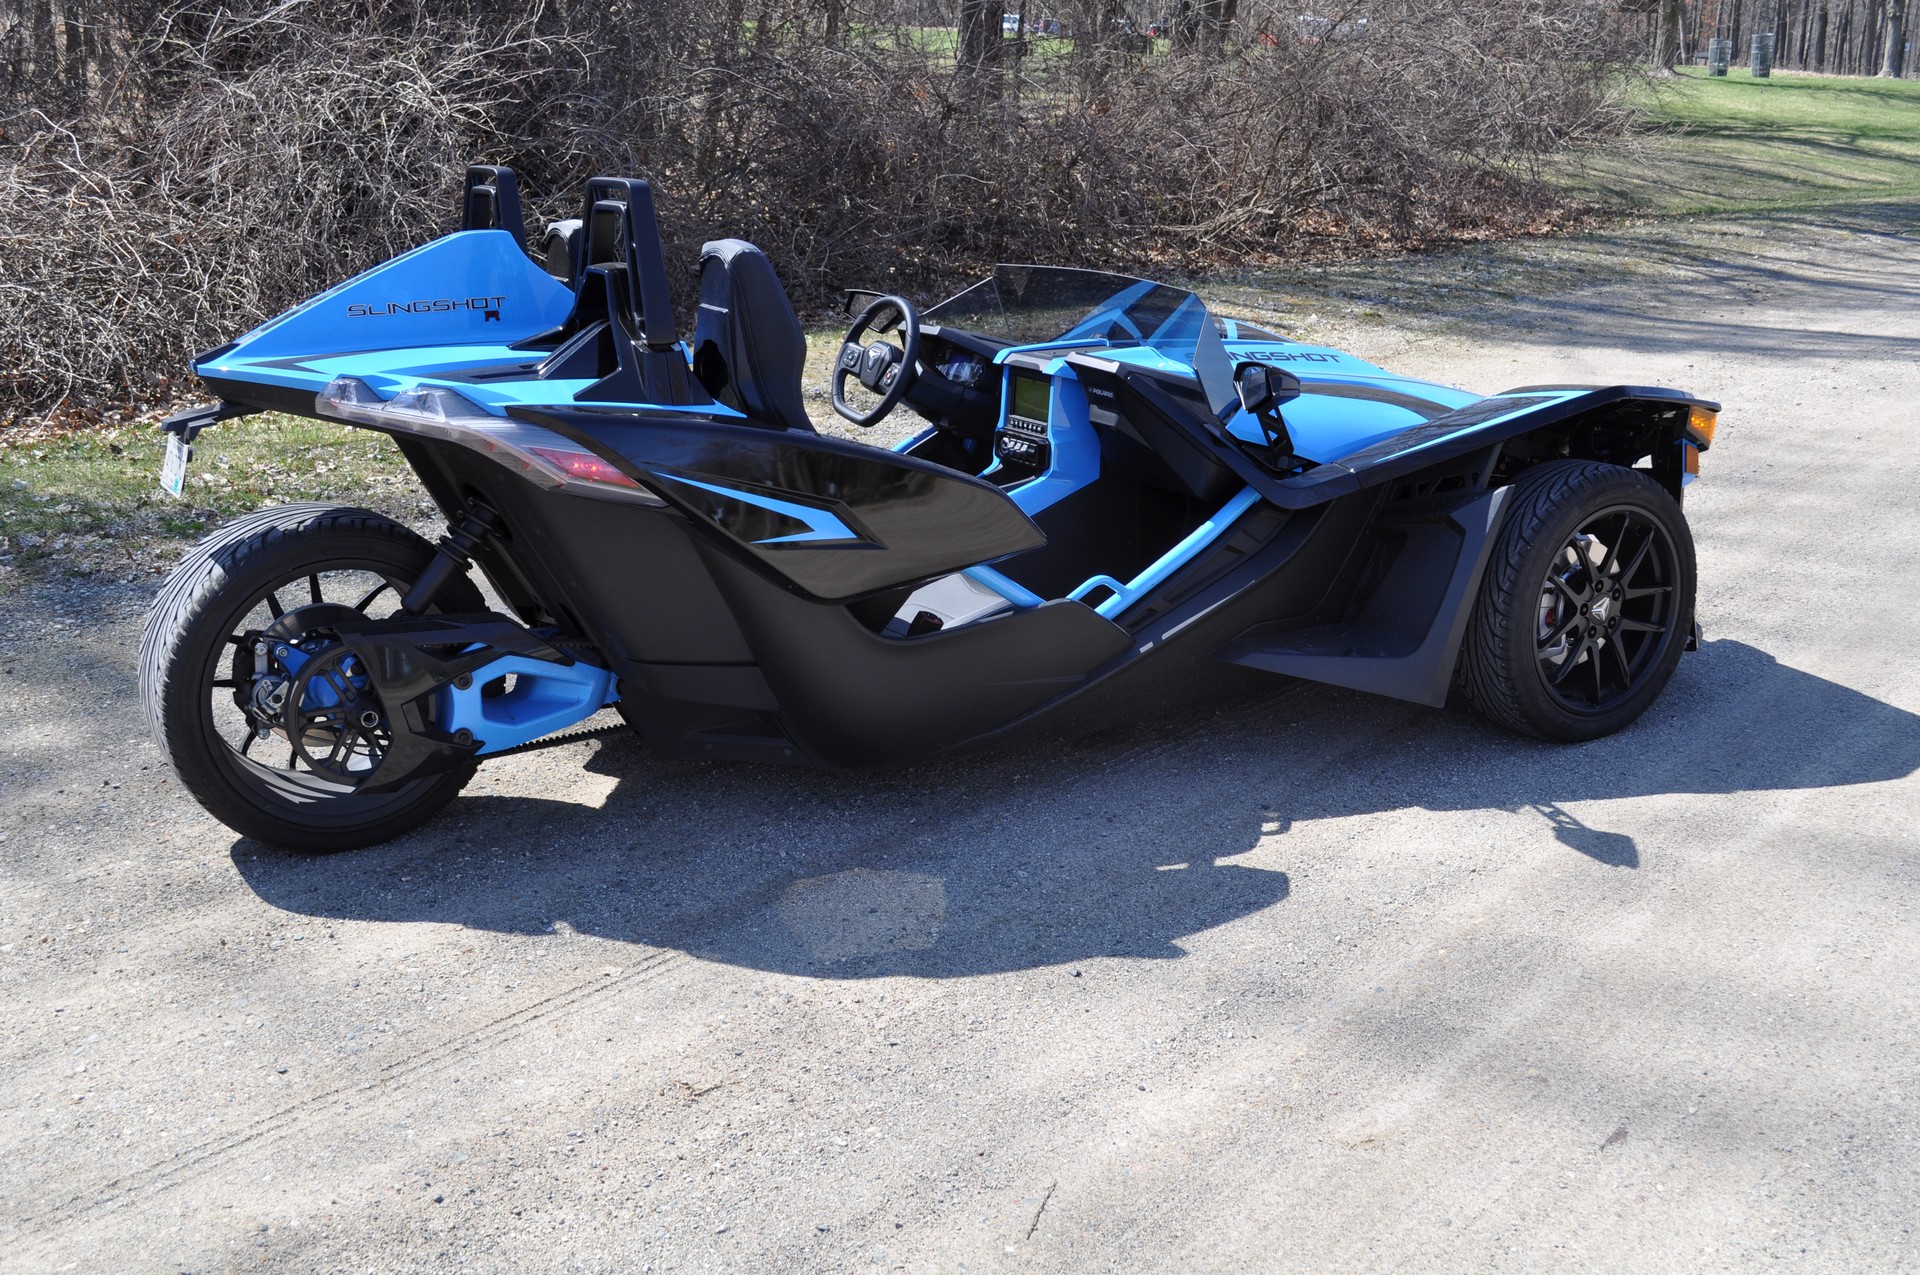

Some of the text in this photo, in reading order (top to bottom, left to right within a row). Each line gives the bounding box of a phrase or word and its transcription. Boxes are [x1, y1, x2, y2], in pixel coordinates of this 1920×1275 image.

[347, 296, 507, 317] SLINGSHOT
[483, 310, 501, 322] R
[1227, 351, 1341, 363] INGSHOT
